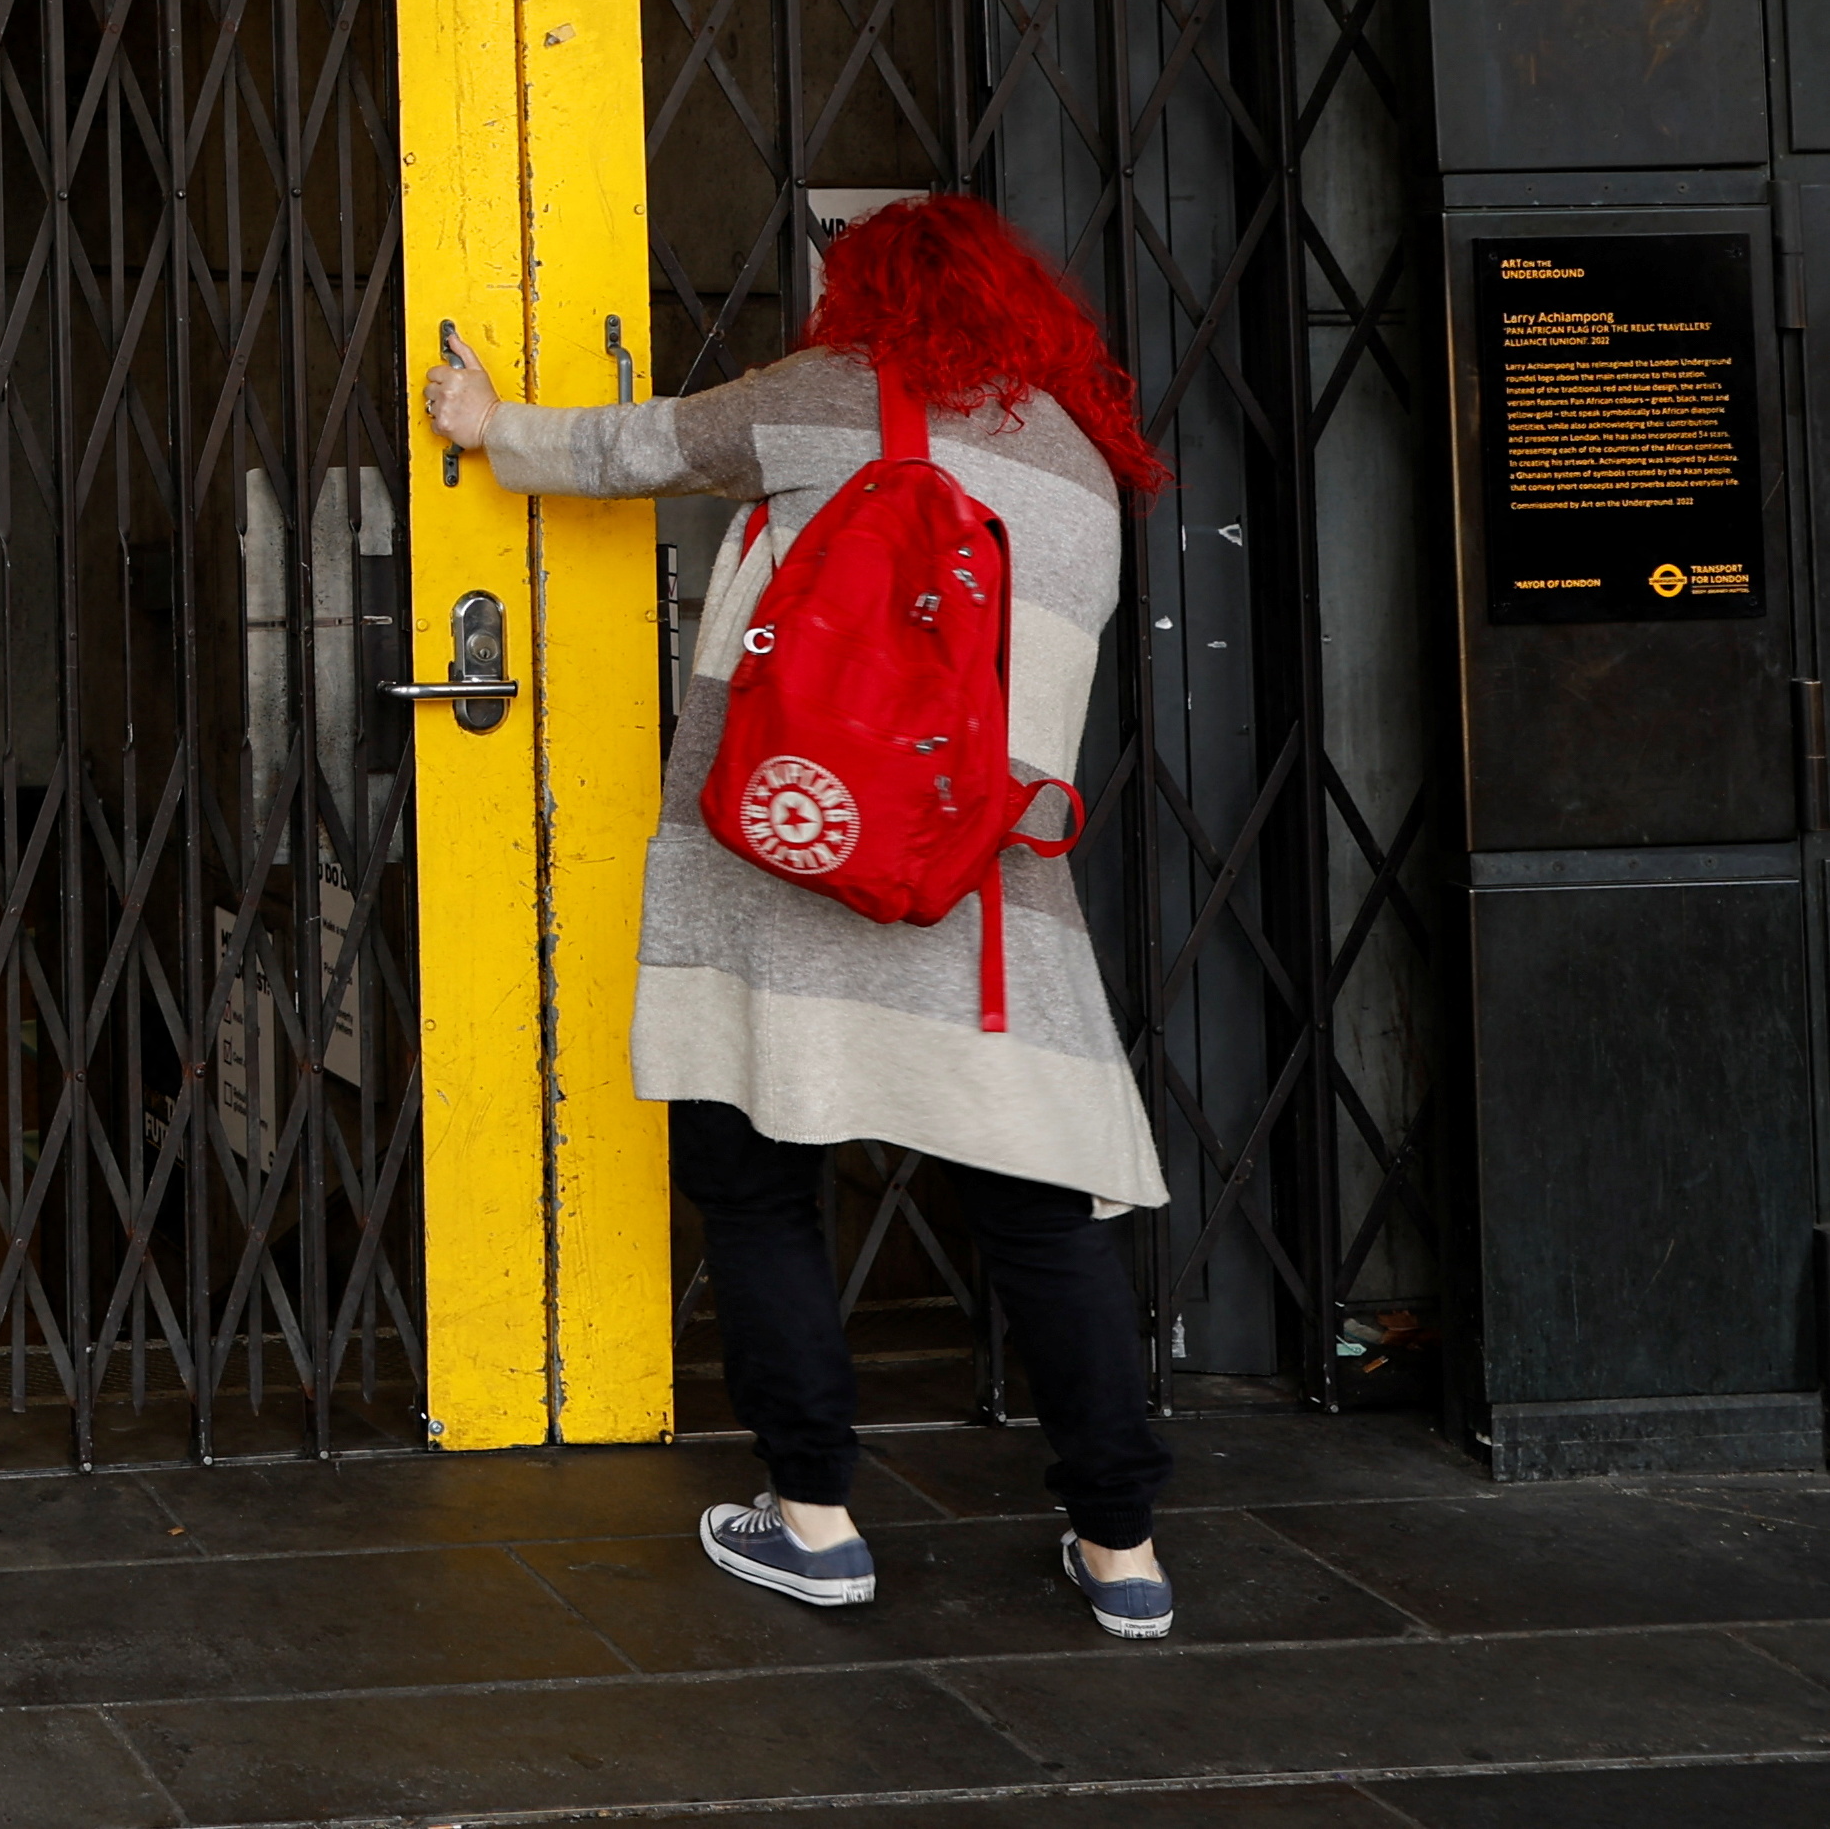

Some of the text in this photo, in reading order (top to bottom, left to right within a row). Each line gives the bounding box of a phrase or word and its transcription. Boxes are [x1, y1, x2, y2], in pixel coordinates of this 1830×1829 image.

[1500, 258, 1521, 268] ART
[1536, 259, 1551, 267] THE
[1501, 268, 1584, 279] UNDERGROUND
[1503, 310, 1614, 325] Larry Achiampong
[1690, 564, 1742, 573] TRANSPORT
[1514, 578, 1601, 589] MAYOR OF LONDON
[1691, 575, 1708, 583] FOR
[1710, 574, 1749, 583] LONDON
